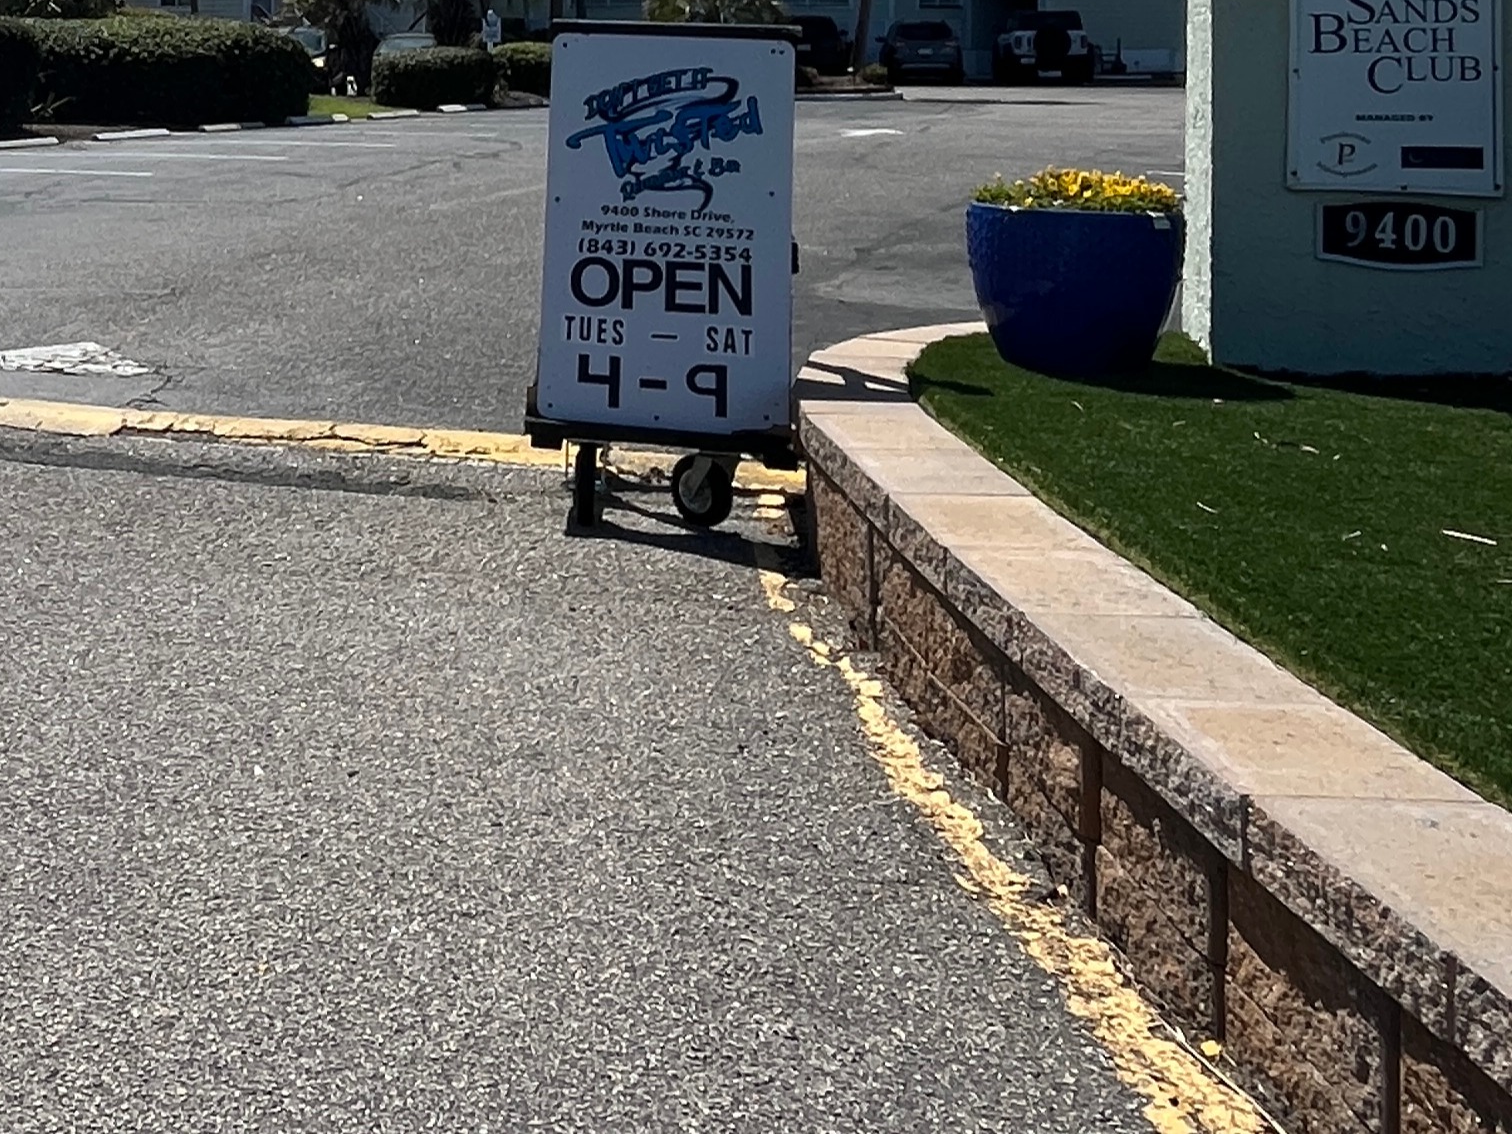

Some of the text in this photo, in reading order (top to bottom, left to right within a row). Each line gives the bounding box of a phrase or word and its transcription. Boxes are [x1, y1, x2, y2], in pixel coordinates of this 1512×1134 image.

[1308, 13, 1456, 54] BEACH
[1367, 56, 1482, 95] CLUB
[581, 220, 754, 241] Myrtle Beach SC 29572
[601, 204, 735, 224] 9400 Shore Drive,
[1345, 211, 1456, 254] 9400
[578, 238, 753, 263] (843) 692-5354
[570, 256, 752, 316] OPEN
[564, 315, 626, 345] TUES
[705, 326, 753, 356] SAT
